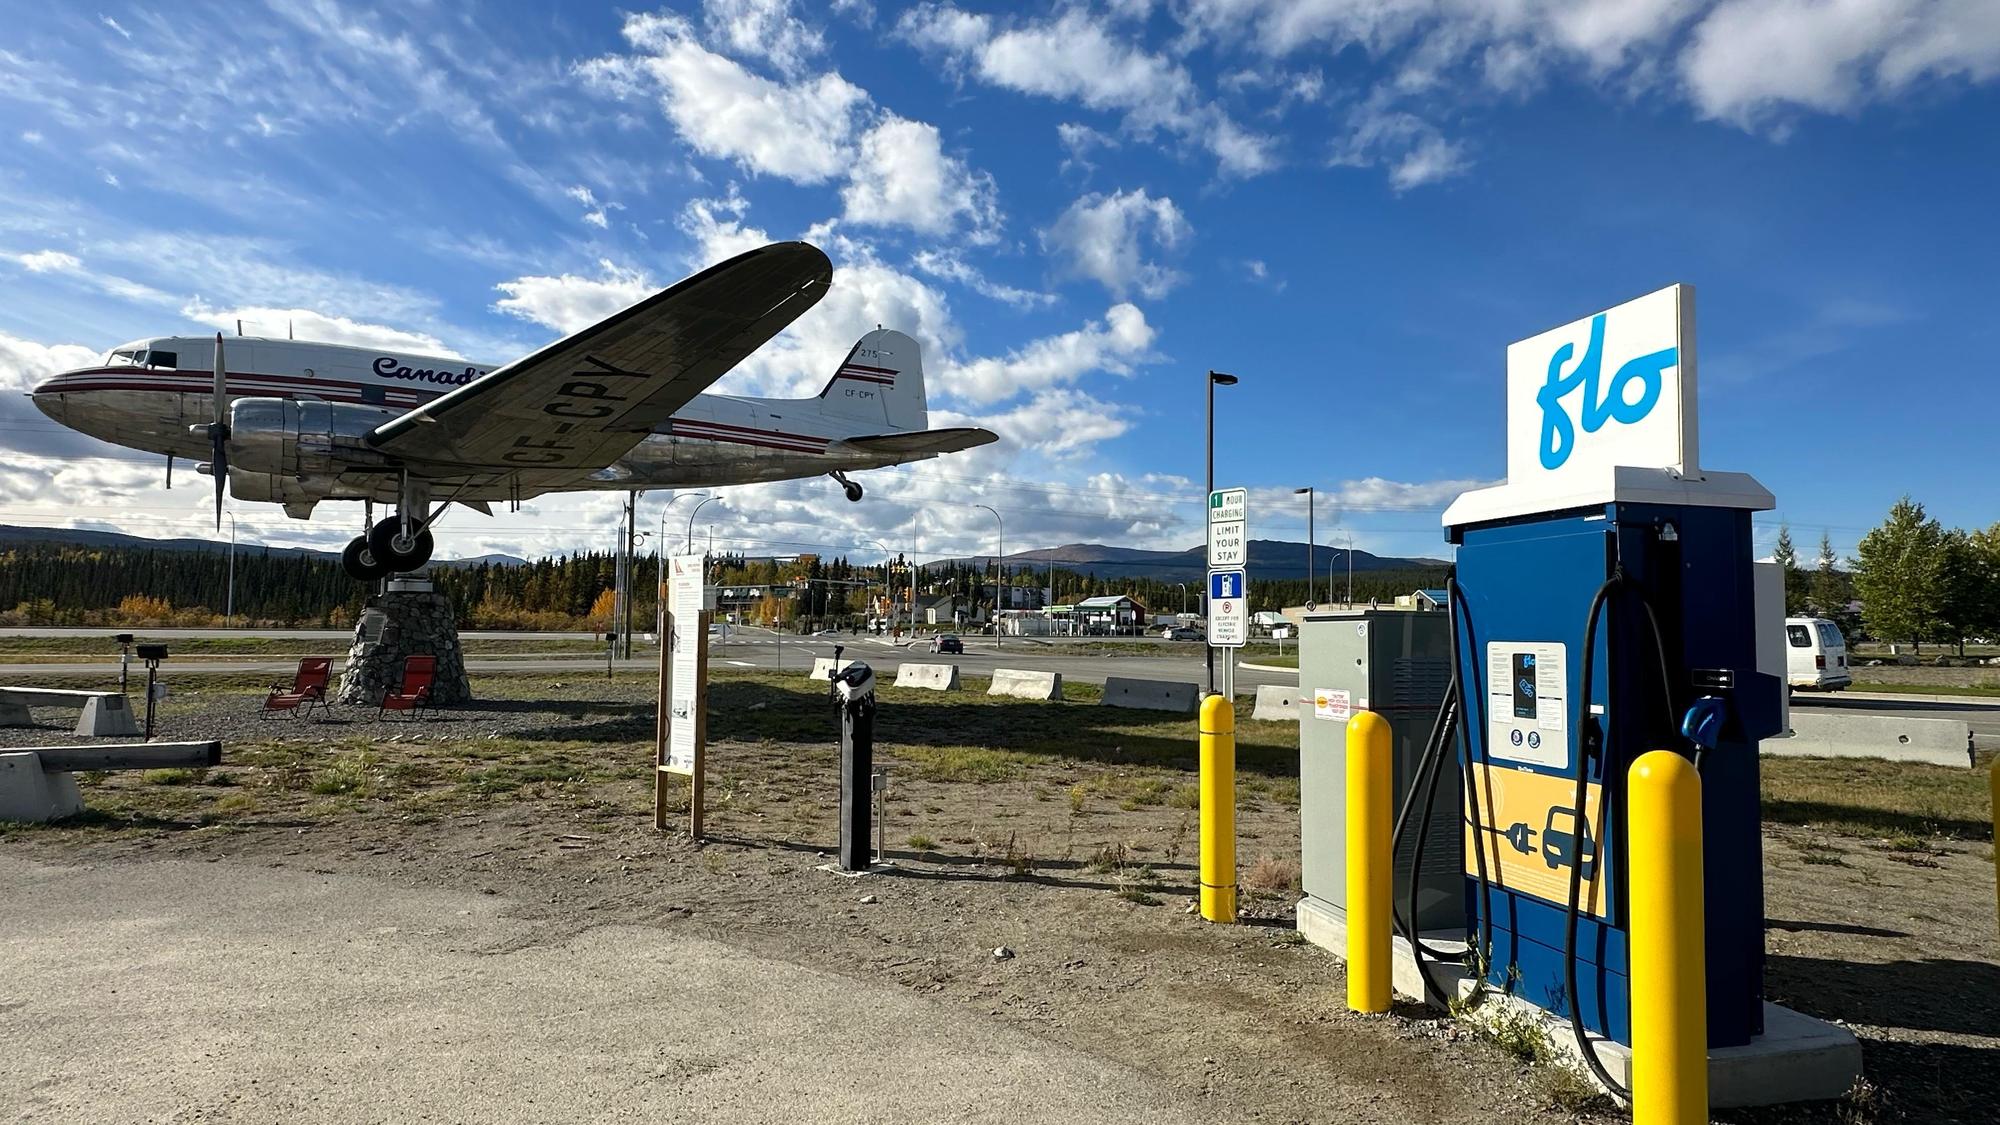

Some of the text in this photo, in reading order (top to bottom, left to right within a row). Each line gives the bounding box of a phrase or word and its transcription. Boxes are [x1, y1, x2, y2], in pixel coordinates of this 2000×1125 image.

[861, 349, 878, 358] 275
[1536, 313, 1678, 470] flo
[501, 355, 652, 463] CF-CPY
[1226, 495, 1243, 505] HOUR
[1213, 509, 1243, 520] CHARGING
[1216, 525, 1240, 535] LIMIT
[1216, 538, 1240, 548] YOUR
[1217, 551, 1238, 561] STAY
